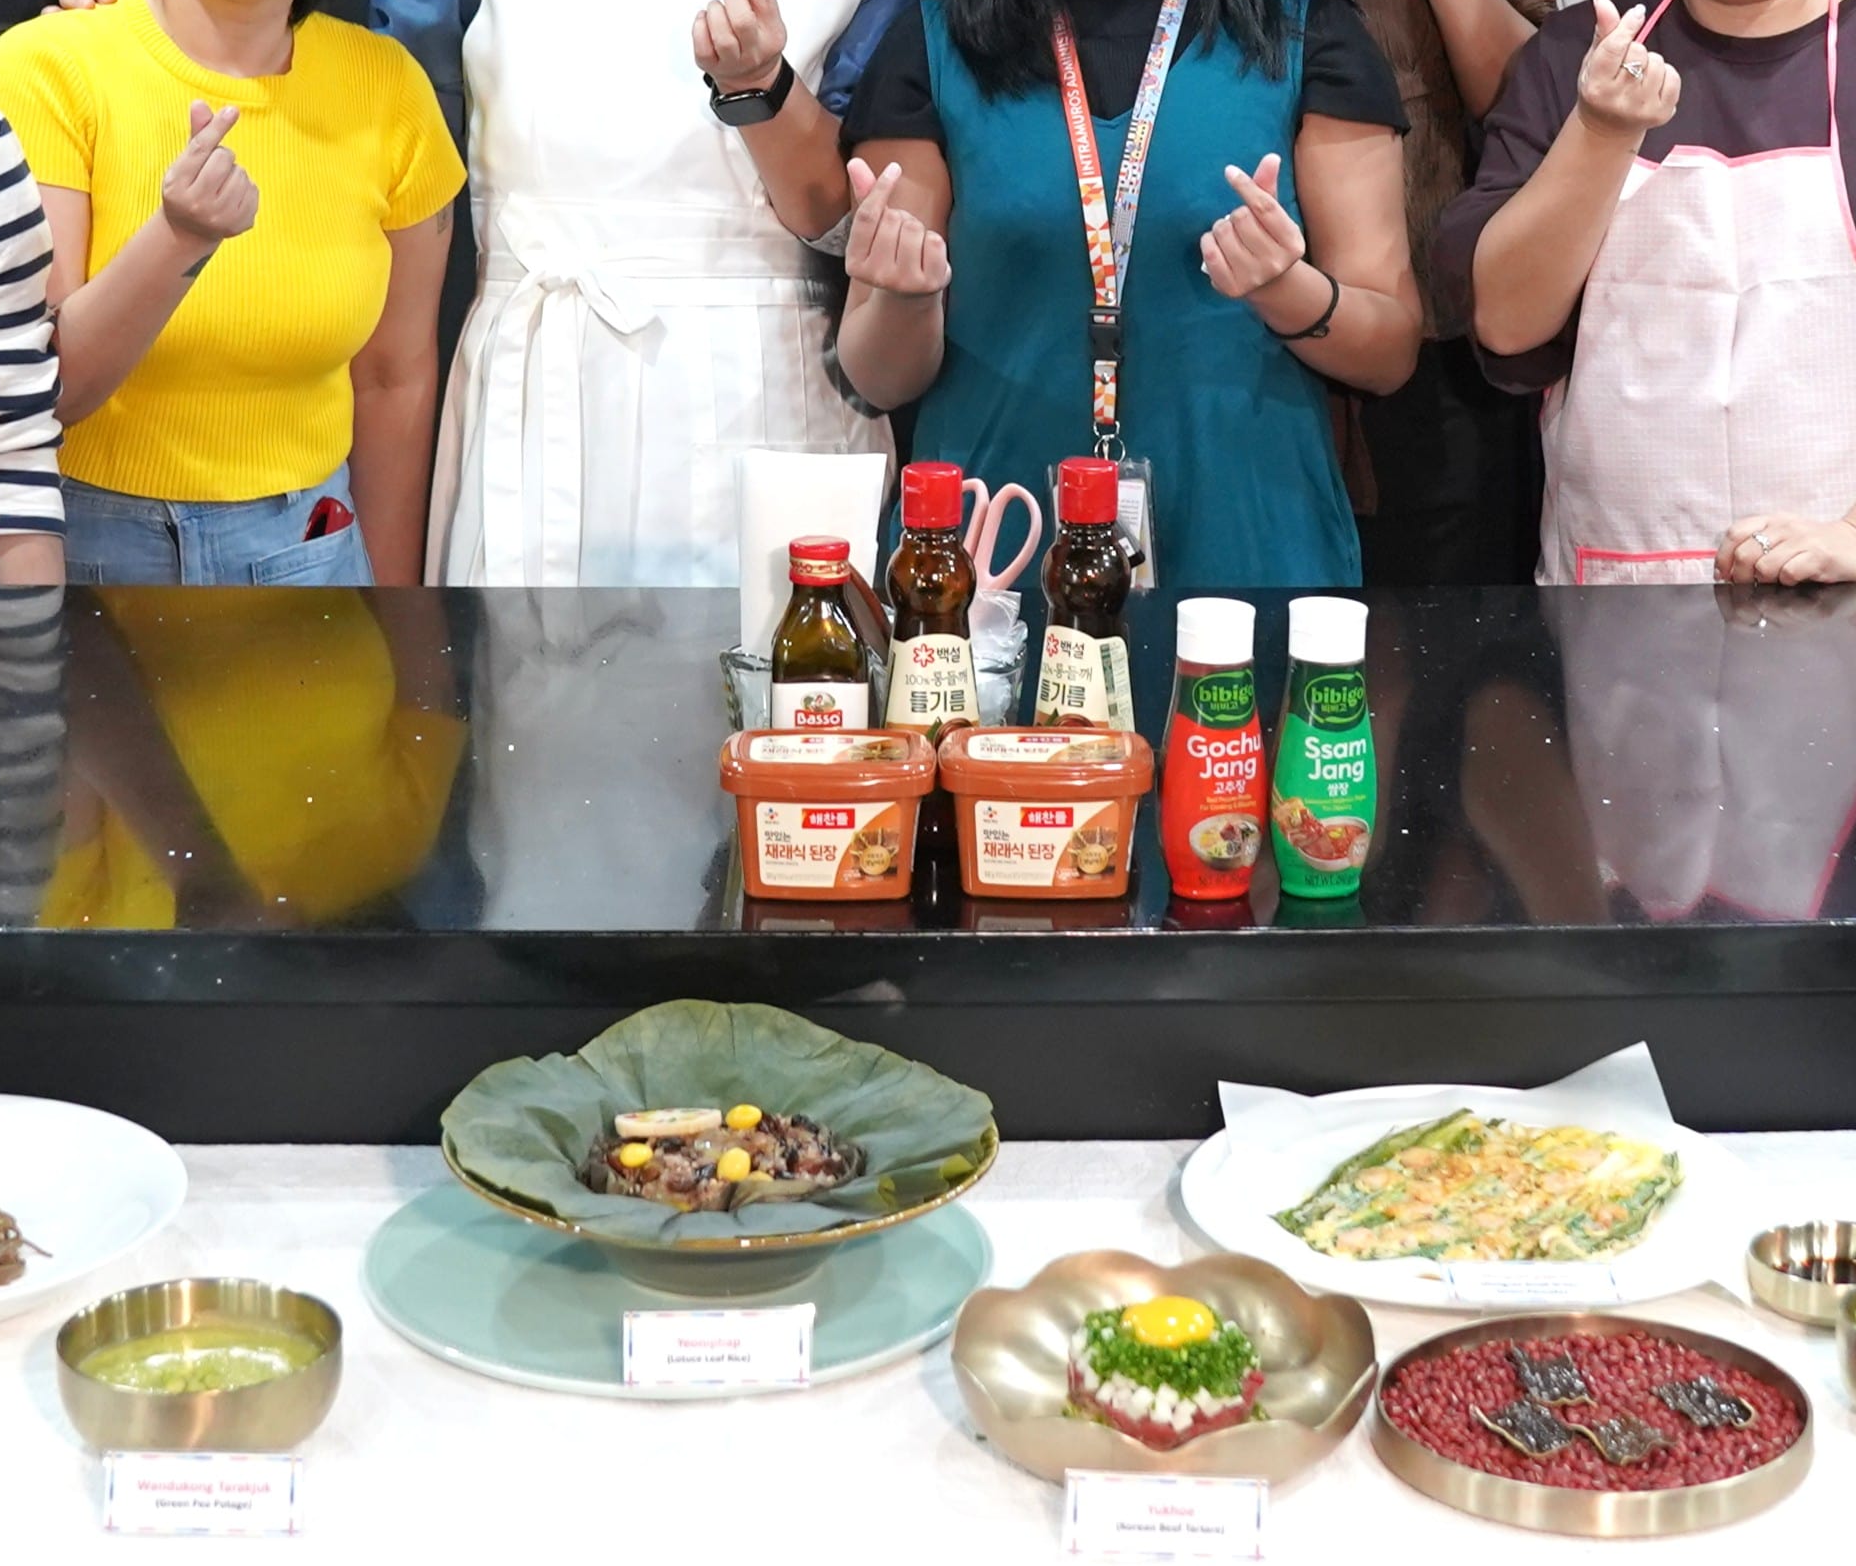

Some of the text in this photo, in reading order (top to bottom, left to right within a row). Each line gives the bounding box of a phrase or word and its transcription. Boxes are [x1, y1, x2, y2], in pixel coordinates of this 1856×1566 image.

[1067, 89, 1095, 175] INTRAMUROS
[936, 646, 961, 664] 백설
[1059, 639, 1085, 660] 백설
[904, 673, 930, 686] 100%
[909, 689, 966, 714] 들기름
[1040, 678, 1086, 709] 들기름
[1199, 684, 1253, 705] bibigo
[1311, 686, 1364, 708] bibigo
[796, 712, 841, 726] Basso
[1187, 732, 1261, 758] Gochu
[1304, 736, 1367, 759] Ssam
[1199, 757, 1257, 780] Jang
[1308, 759, 1365, 783] Jang
[1213, 779, 1247, 795] 고추장
[1326, 782, 1349, 796] 쌈장
[808, 811, 849, 827] 해찬들
[1027, 811, 1068, 825] 해찬들
[764, 830, 792, 843] 맛있는
[983, 829, 1010, 841] 맛있는
[764, 844, 838, 862] 재래식 된장
[983, 842, 1055, 860] 재래식 된장
